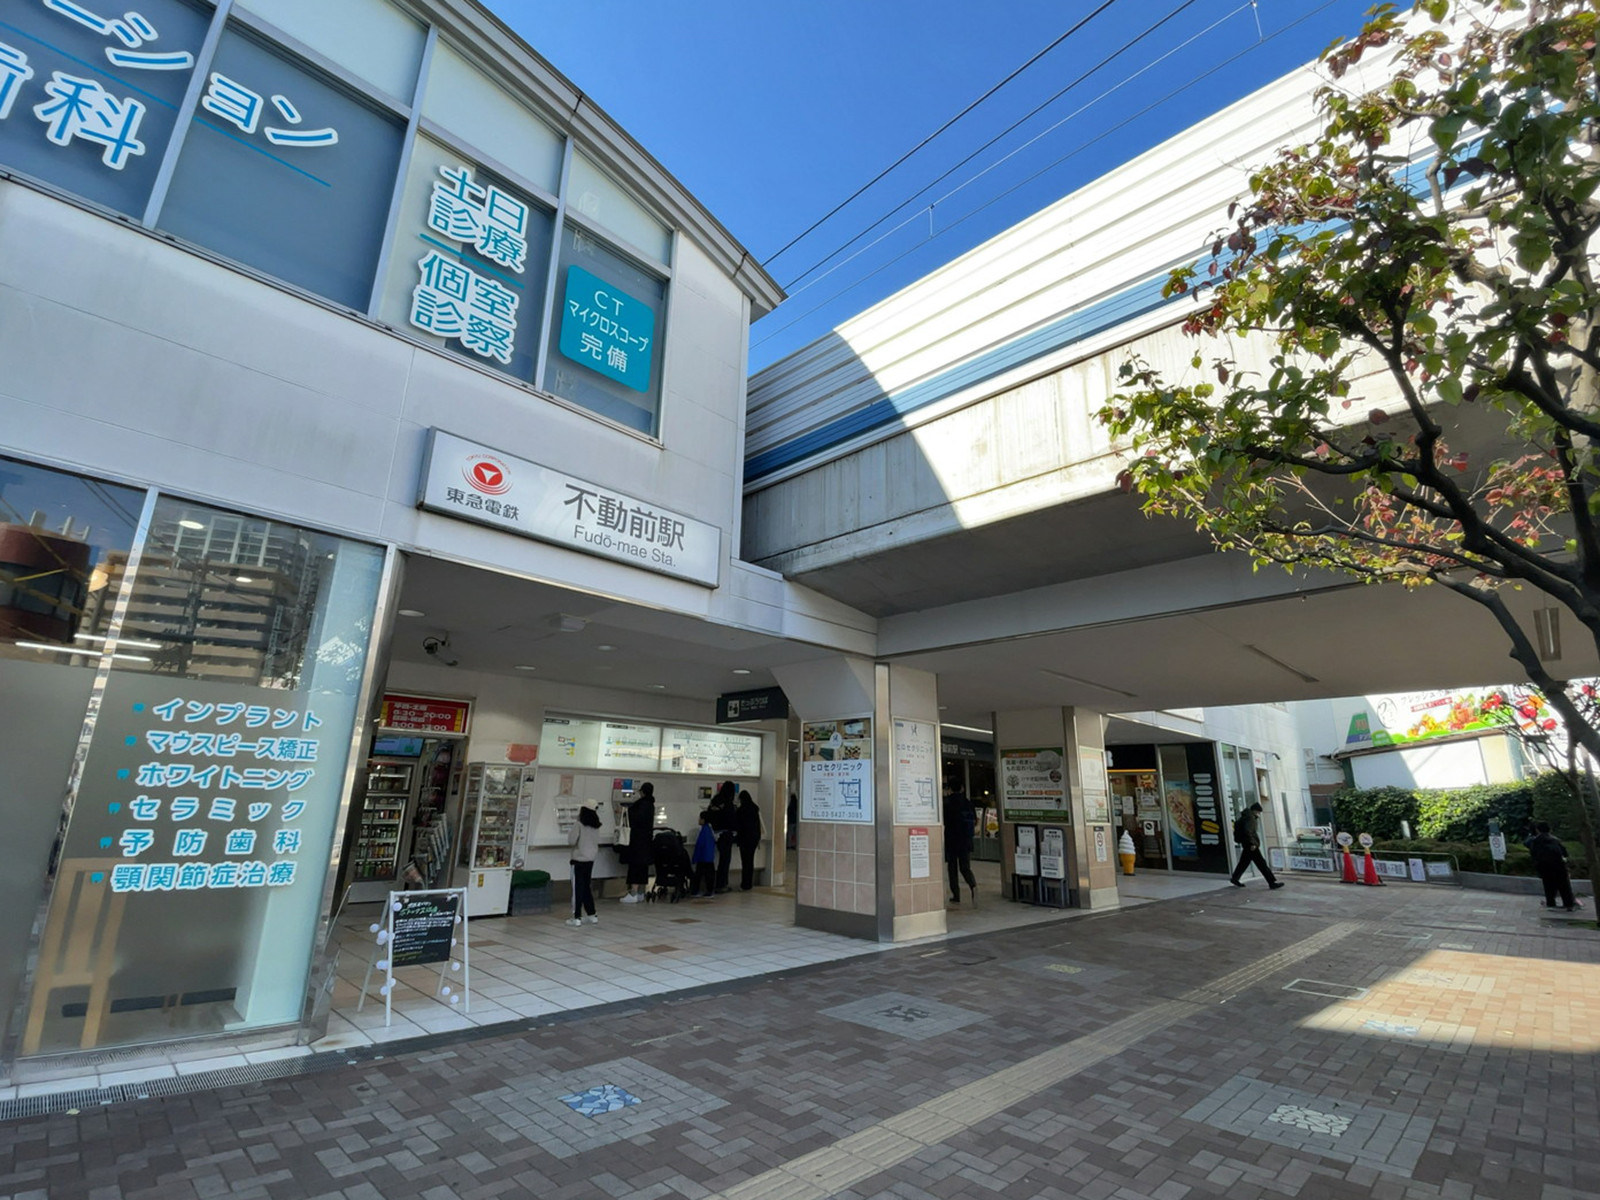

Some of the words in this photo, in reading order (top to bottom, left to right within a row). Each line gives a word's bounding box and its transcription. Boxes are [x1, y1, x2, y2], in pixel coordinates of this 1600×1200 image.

[438, 164, 529, 238] 土日
[427, 181, 527, 274] 診療
[418, 249, 519, 329] 個室
[594, 289, 625, 316] CT
[409, 284, 514, 364] 診察
[567, 298, 650, 353] マイクロスコープ
[580, 332, 629, 373] 完備
[446, 486, 519, 521] 東急電鉄
[563, 482, 685, 552] 不動前駅
[651, 547, 677, 568] Sta.
[153, 698, 322, 731] インプラント
[146, 730, 318, 761] マウスピース矯正
[136, 762, 313, 791] ホワイトニング
[810, 762, 863, 772] ヒロセクリニック
[130, 795, 306, 822] セラミック
[119, 828, 301, 857] 予防歯科
[110, 860, 296, 892] 顎関節症治療
